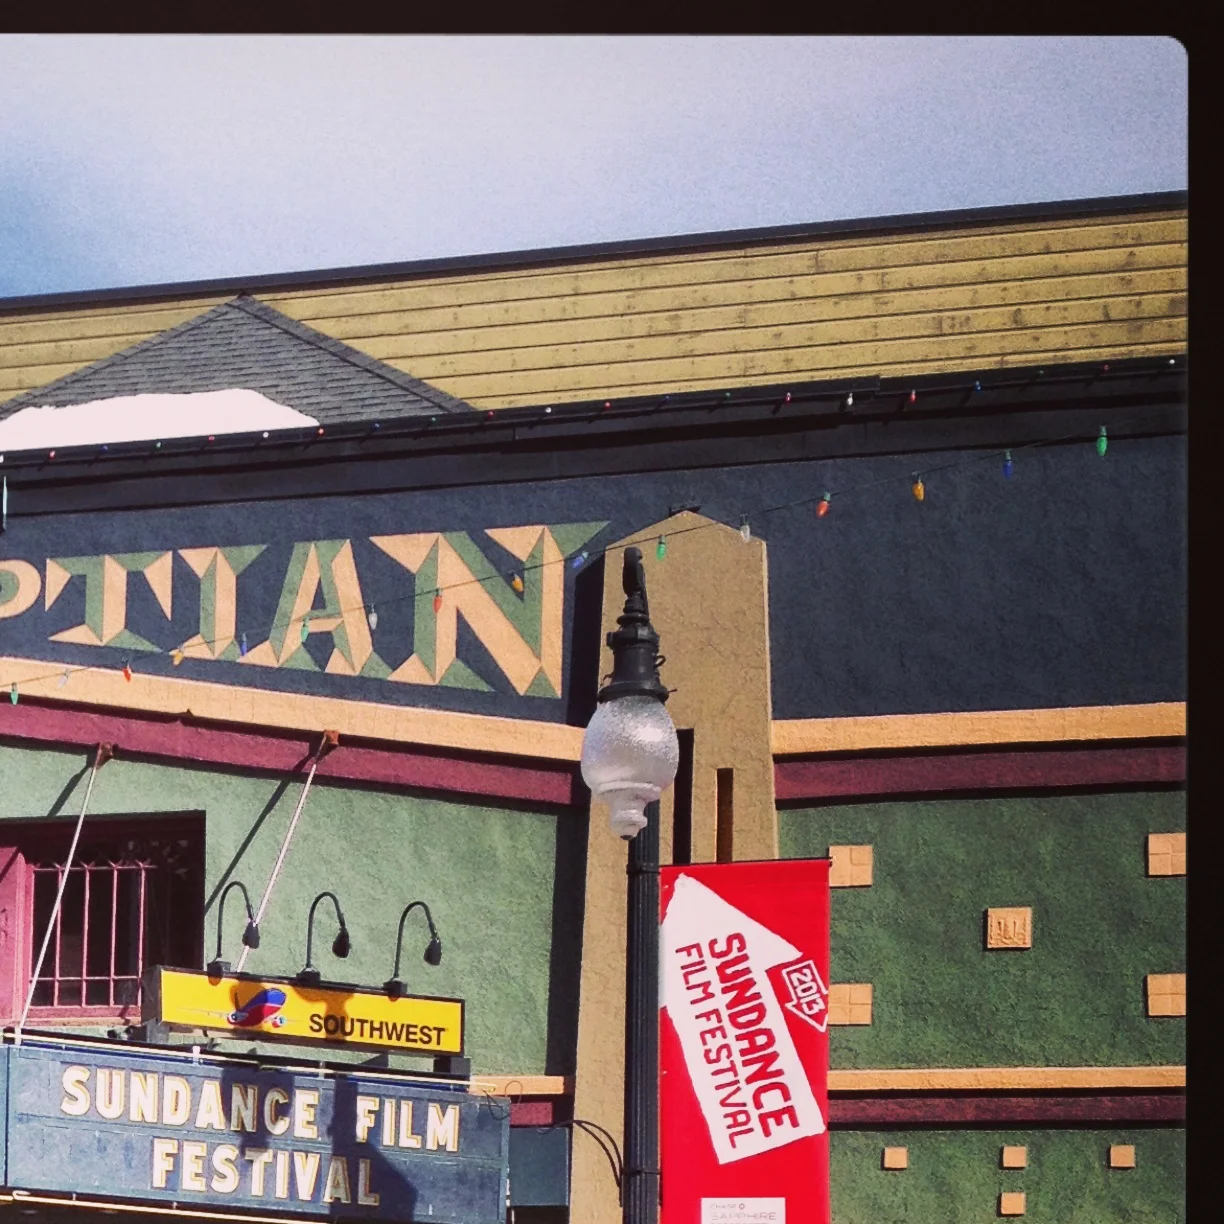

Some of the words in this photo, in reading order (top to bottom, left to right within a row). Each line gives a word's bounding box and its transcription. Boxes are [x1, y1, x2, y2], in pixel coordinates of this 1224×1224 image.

[675, 942, 716, 1005] FILM
[789, 968, 827, 1016] 2013
[309, 1013, 446, 1047] SOUTHWEST
[708, 932, 801, 1138] SUNDANCE
[60, 1065, 321, 1140] SUNDANCE
[356, 1096, 460, 1153] FILM
[695, 1012, 755, 1150] FESTIVAL
[152, 1137, 380, 1206] FESTIVAL
